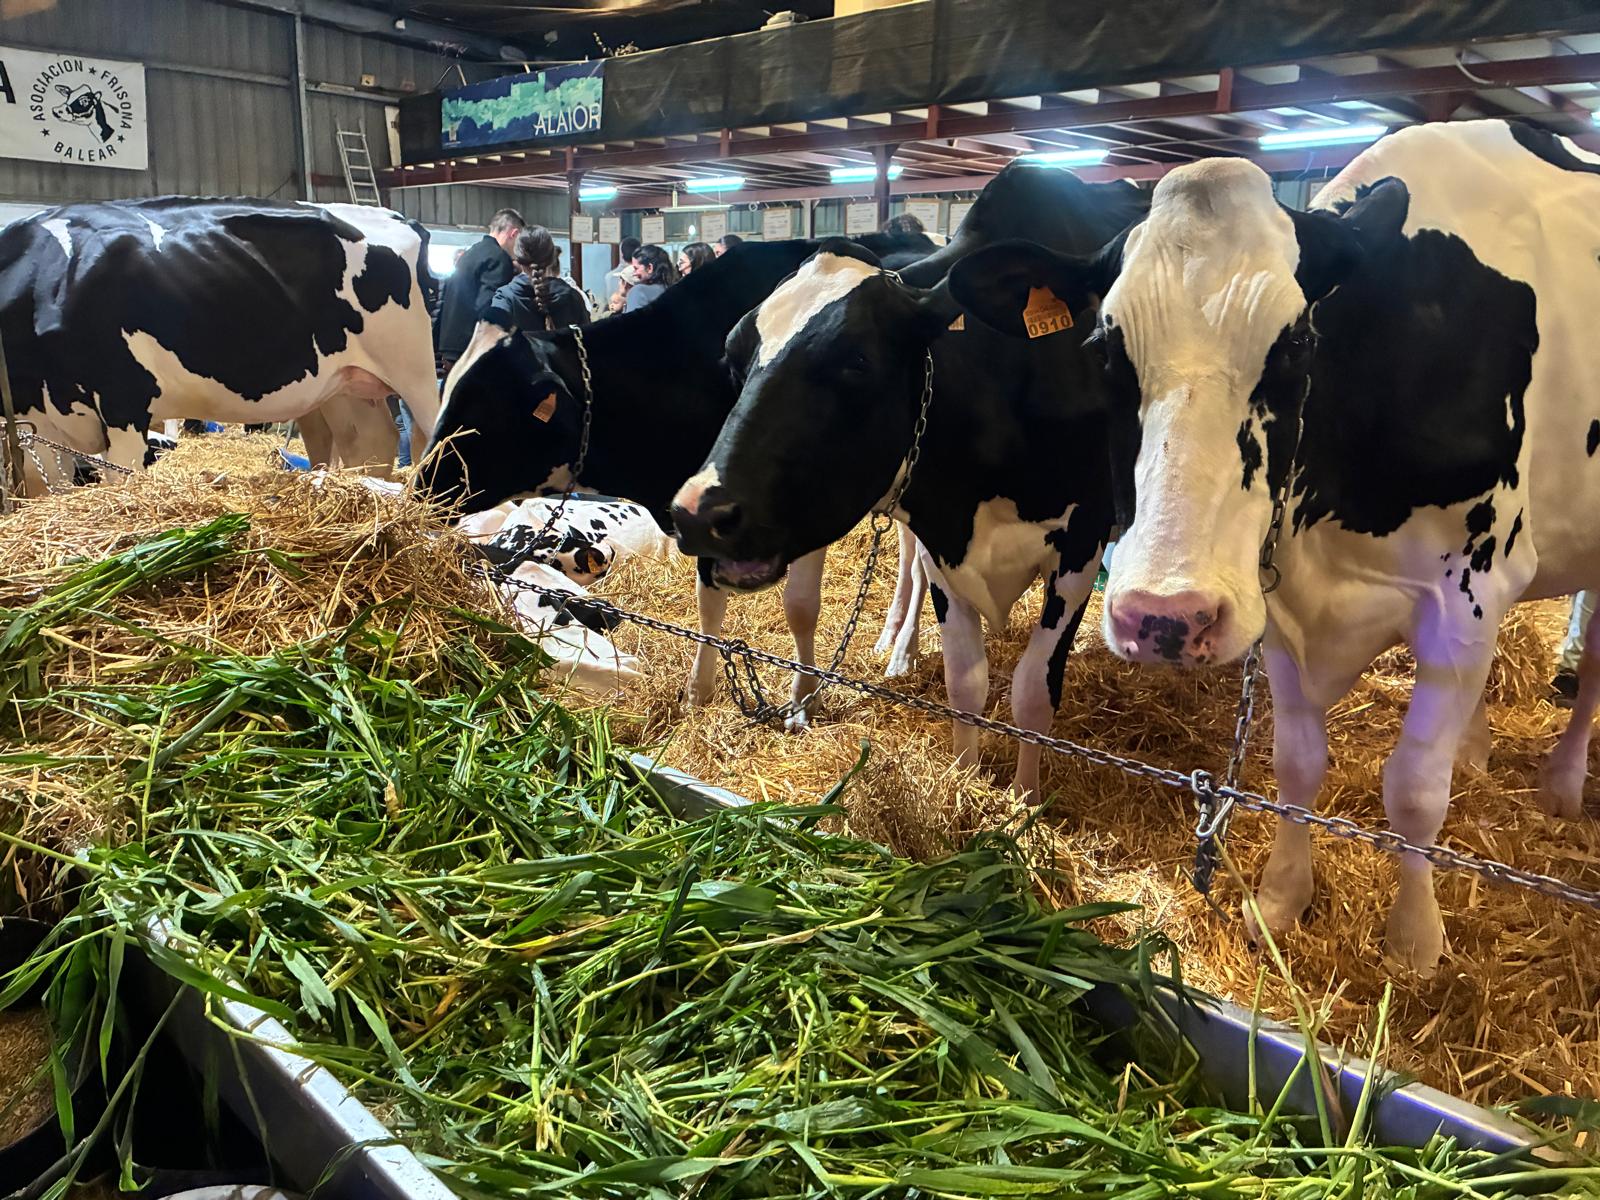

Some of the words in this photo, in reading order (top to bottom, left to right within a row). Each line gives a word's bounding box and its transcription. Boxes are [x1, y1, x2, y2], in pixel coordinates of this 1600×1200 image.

[30, 60, 84, 121] ASOCIACION
[100, 70, 133, 129] FRISONA
[534, 104, 601, 135] ALAIOR
[54, 141, 117, 162] BALEAR
[1028, 315, 1070, 336] 0910
